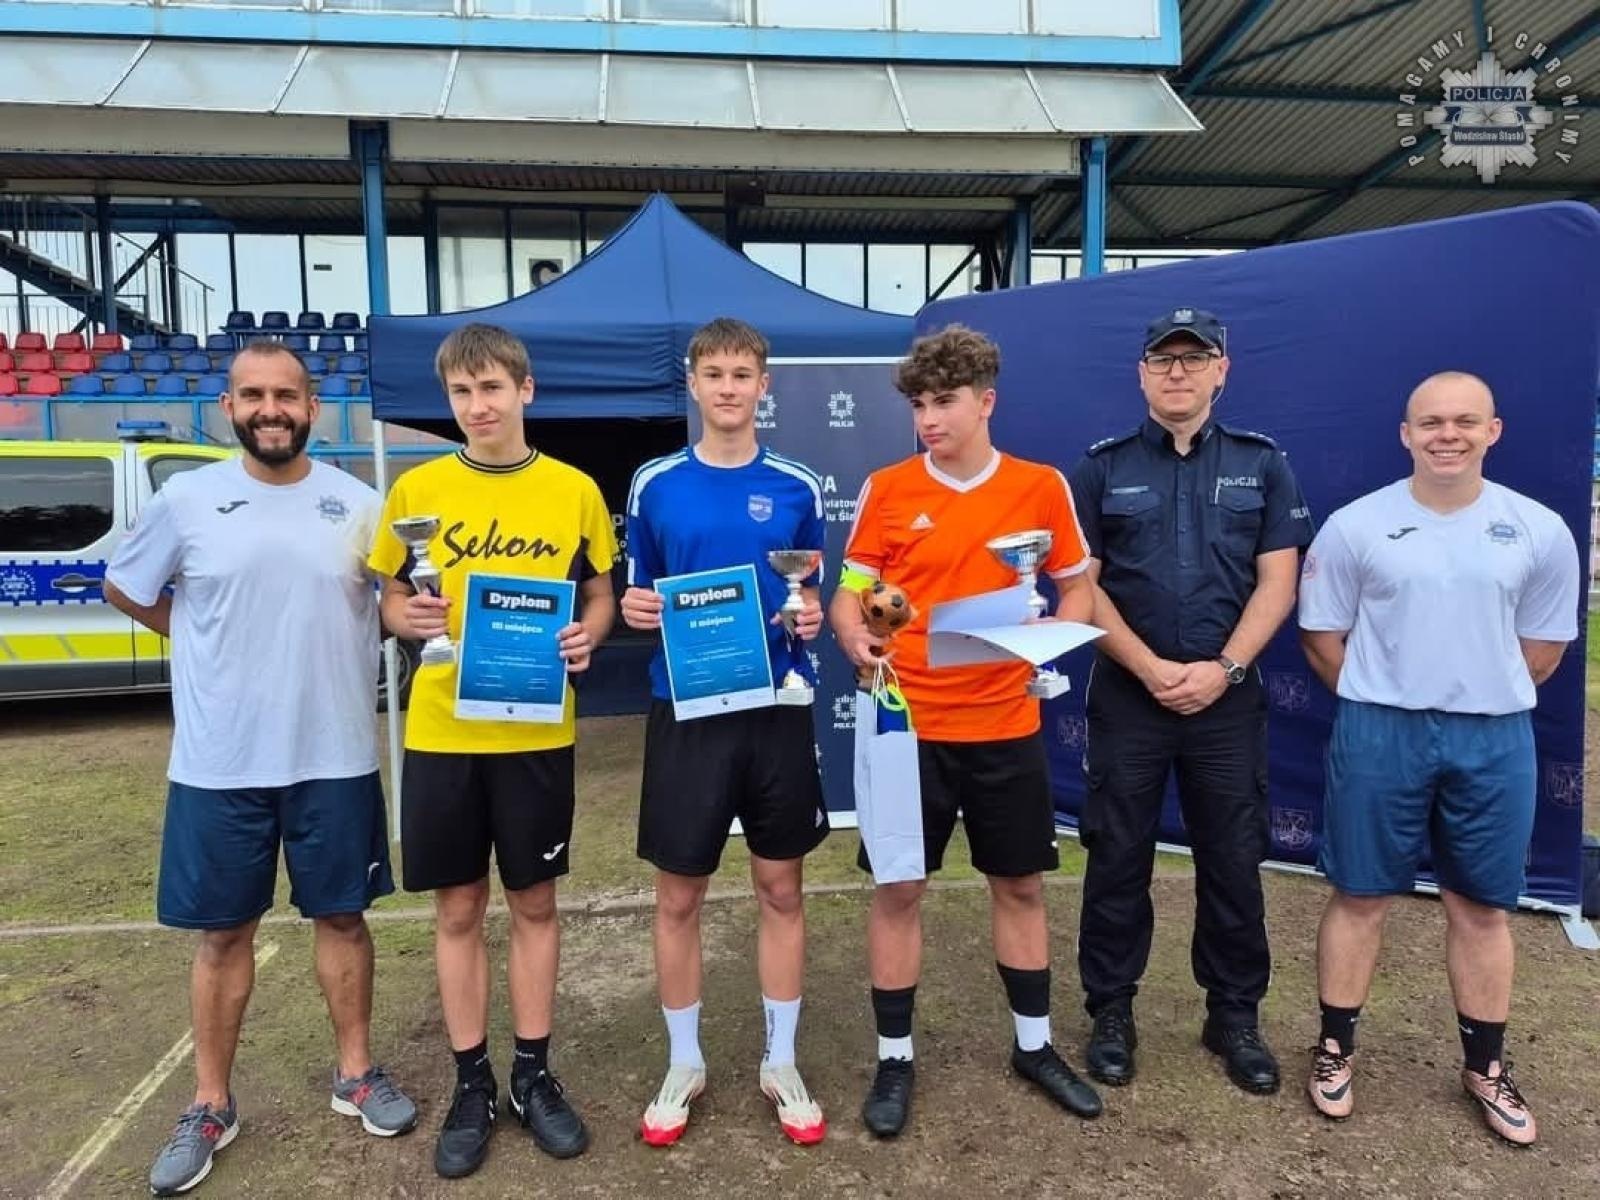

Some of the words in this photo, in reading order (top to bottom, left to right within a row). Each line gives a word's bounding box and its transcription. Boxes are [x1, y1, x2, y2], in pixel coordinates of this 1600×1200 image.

[829, 420, 855, 428] POLICJA
[1217, 476, 1258, 487] POLICJA
[442, 518, 560, 568] Sekon
[489, 592, 551, 609] Dyplom
[679, 587, 737, 606] Dyplom
